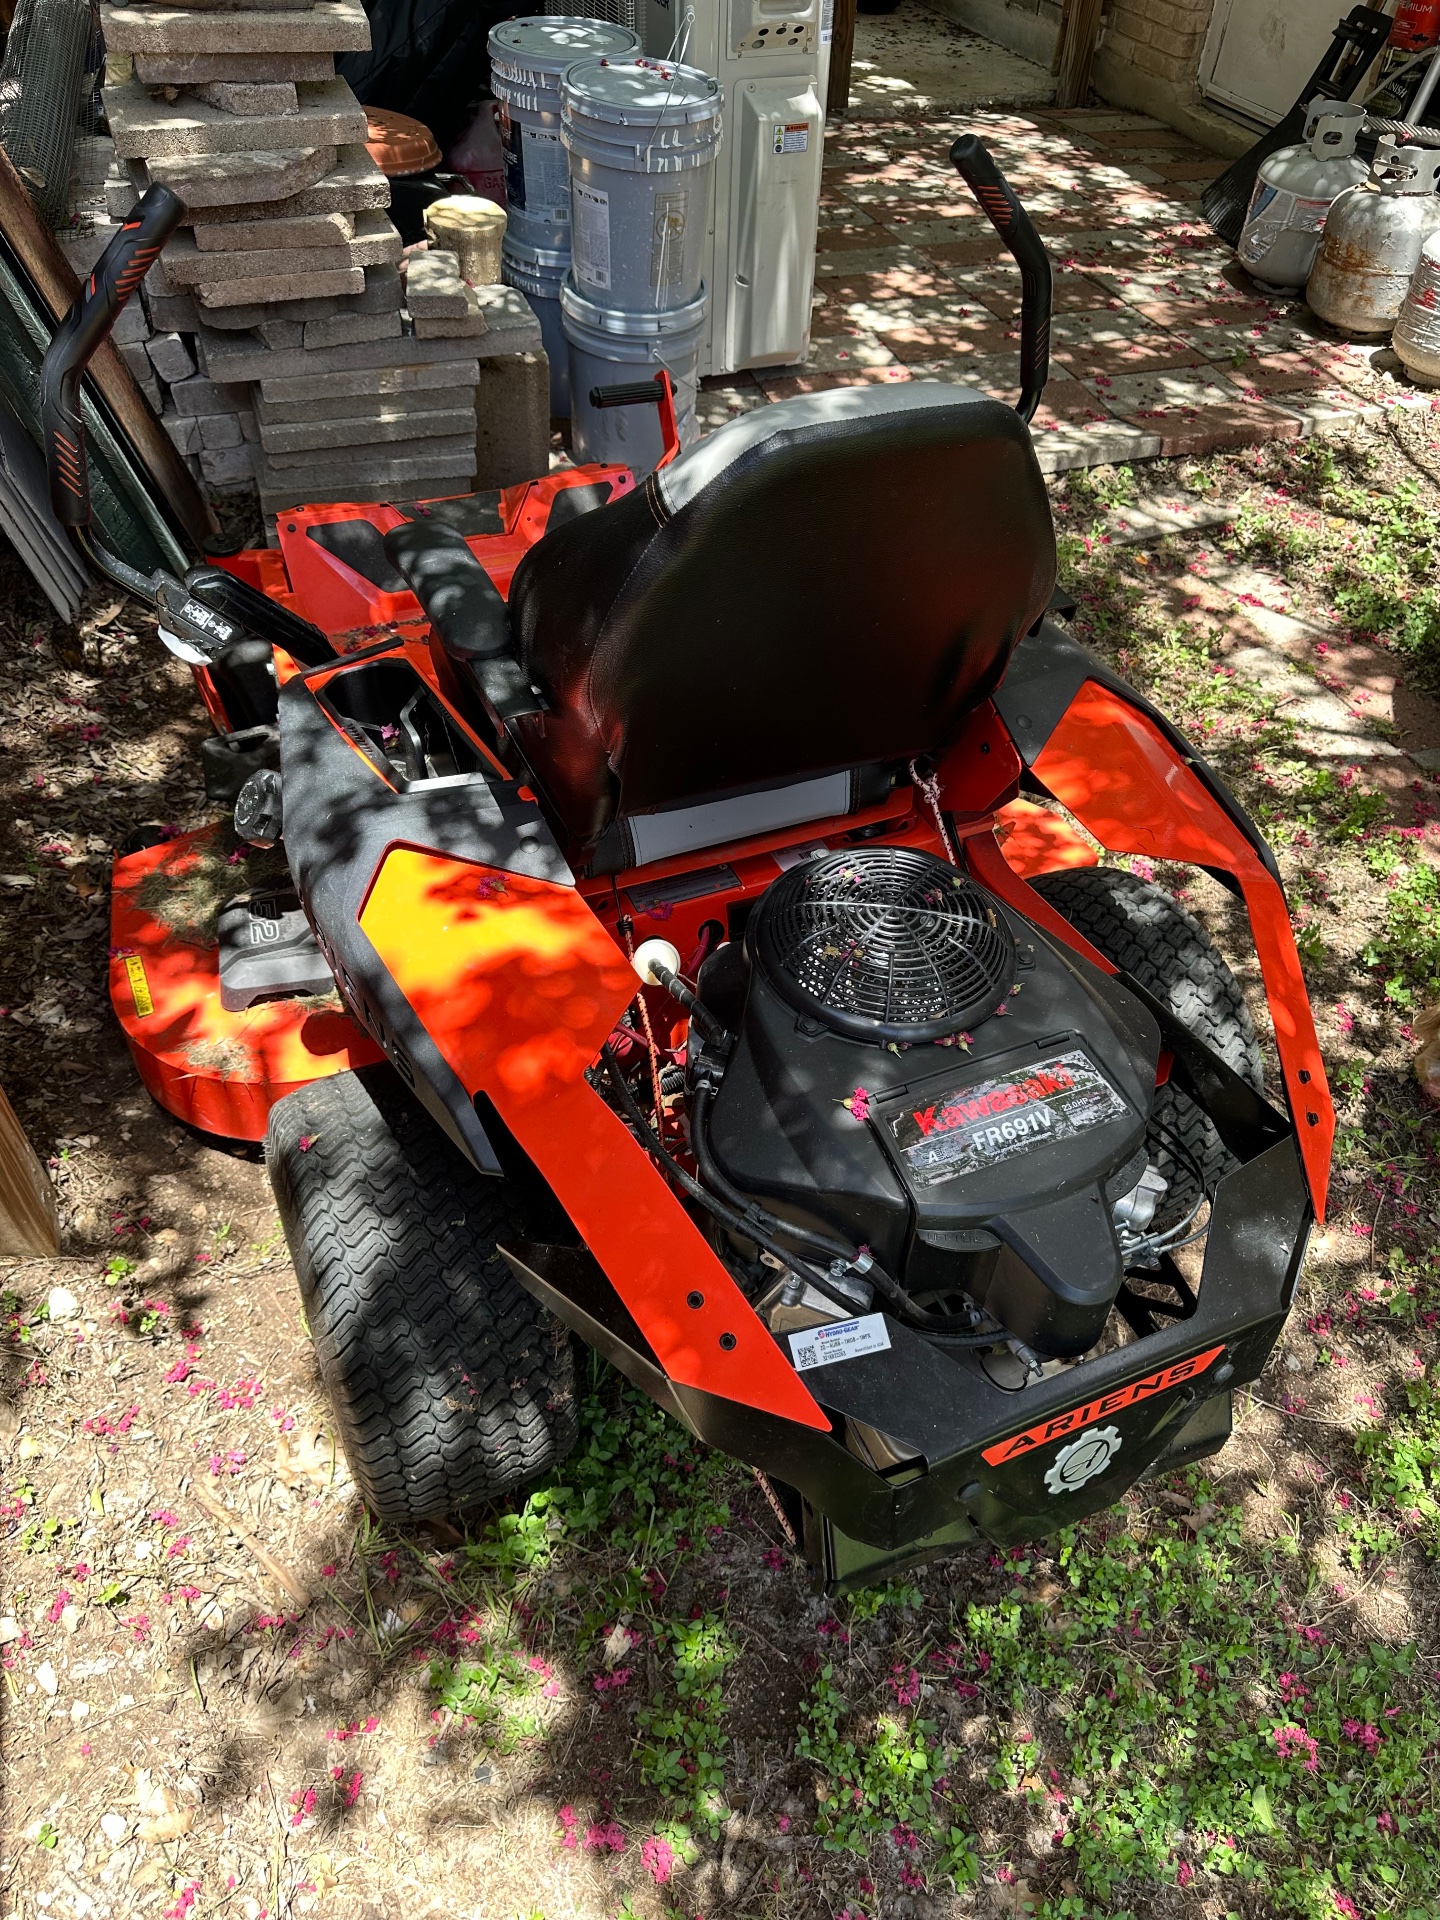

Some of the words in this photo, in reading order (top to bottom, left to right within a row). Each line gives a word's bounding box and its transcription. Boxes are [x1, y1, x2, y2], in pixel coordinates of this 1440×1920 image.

[912, 1062, 1075, 1137] Kawasaki
[972, 1108, 1053, 1151] FR691V
[1112, 1174, 1129, 1191] LIFT
[1127, 1154, 1146, 1175] HERE
[1002, 1360, 1197, 1458] ARIENS
